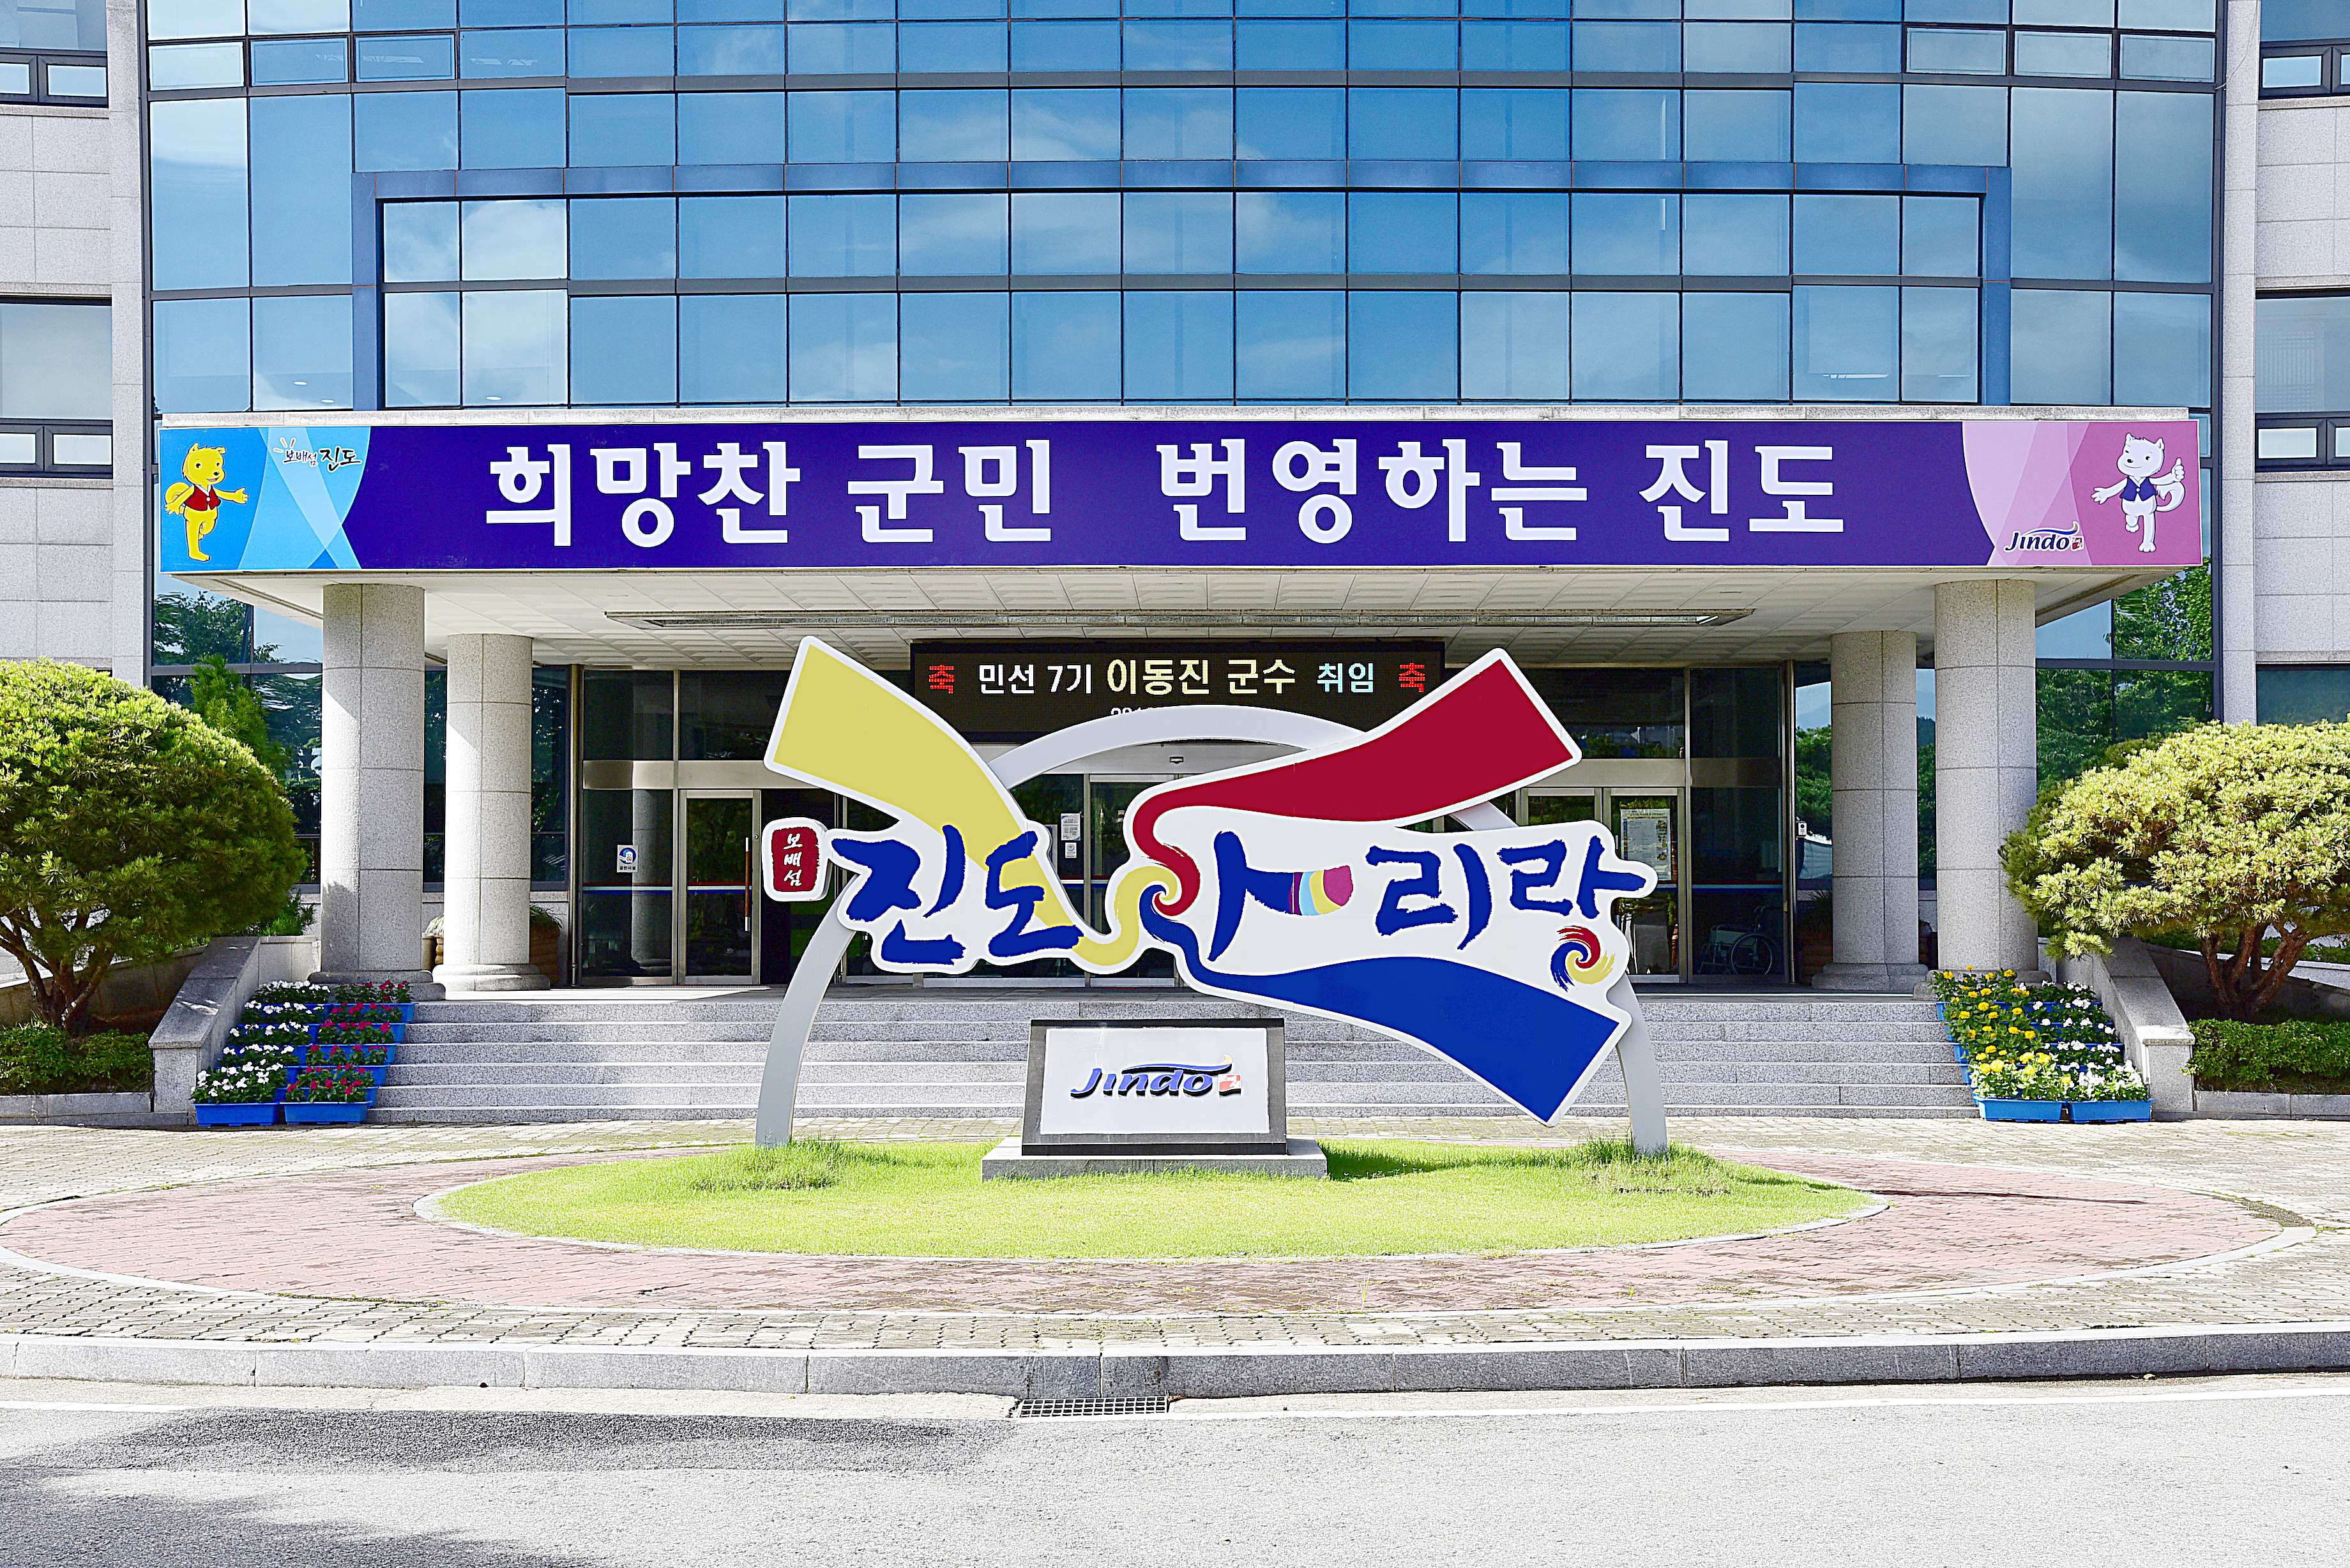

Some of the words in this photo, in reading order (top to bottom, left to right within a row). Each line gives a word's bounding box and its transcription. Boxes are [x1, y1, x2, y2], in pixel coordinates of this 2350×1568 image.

[284, 450, 317, 466] 보배섬
[319, 447, 361, 471] 진도
[485, 441, 802, 549] 희망찬
[846, 439, 1054, 544] 군민
[1156, 438, 1589, 545] 번영하는
[1639, 439, 1845, 543] 진도
[2005, 532, 2070, 551] Jindo
[929, 663, 957, 695] 축
[978, 663, 1036, 695] 민선
[1047, 663, 1093, 695] 7기
[1106, 659, 1210, 696] 이동진
[1227, 658, 1297, 695] 군수
[1317, 662, 1375, 694] 취임
[1399, 662, 1427, 693] 축
[783, 833, 803, 887] 보배섬
[831, 824, 1084, 966] 진도
[1070, 1068, 1213, 1098] Jindo
